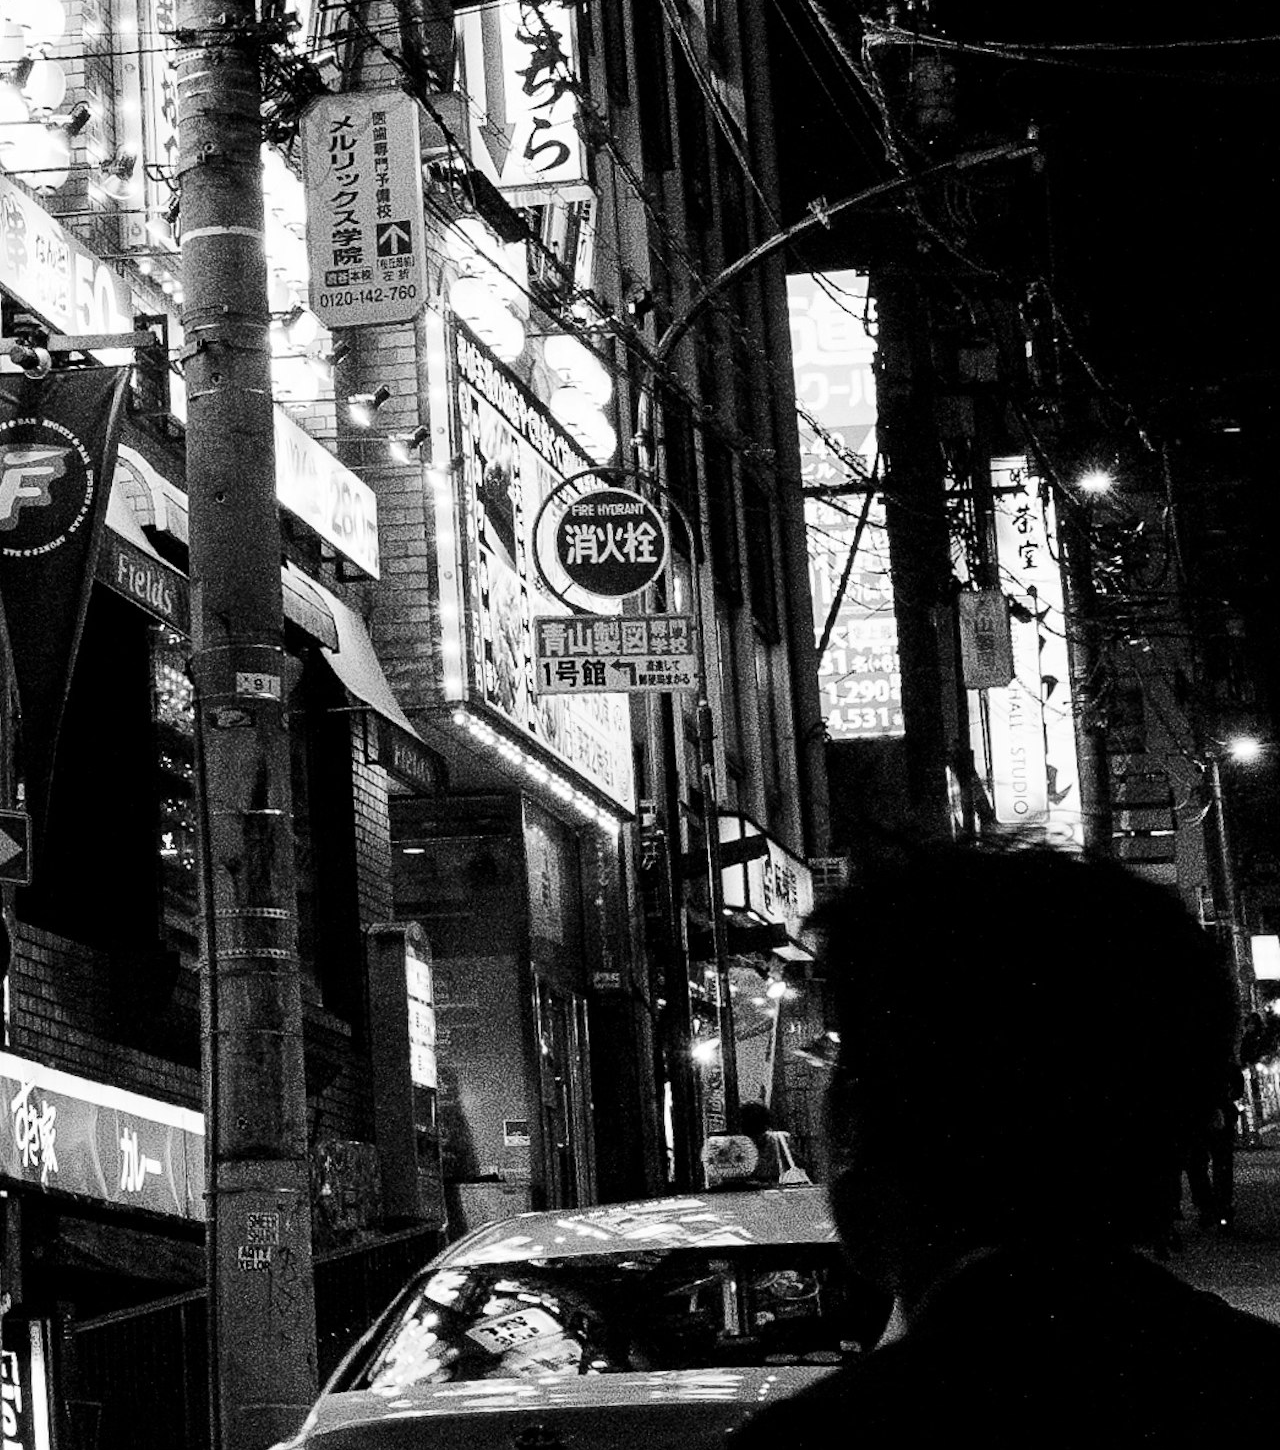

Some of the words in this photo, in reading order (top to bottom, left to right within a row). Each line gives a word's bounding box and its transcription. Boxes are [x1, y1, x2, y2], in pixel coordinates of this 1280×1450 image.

[328, 115, 363, 267] メルリックス学院
[320, 284, 417, 308] 0120-142-760
[571, 503, 595, 517] FIRE
[597, 502, 646, 517] HYDRANT
[564, 521, 658, 565] 消火栓
[117, 552, 172, 615] Fields
[541, 620, 648, 657] 青山製図
[543, 660, 607, 687] 1号館
[1008, 688, 1021, 725] HALL
[1011, 747, 1029, 816] STUDIO
[10, 1073, 60, 1187] すき家
[120, 1127, 163, 1194] カレー
